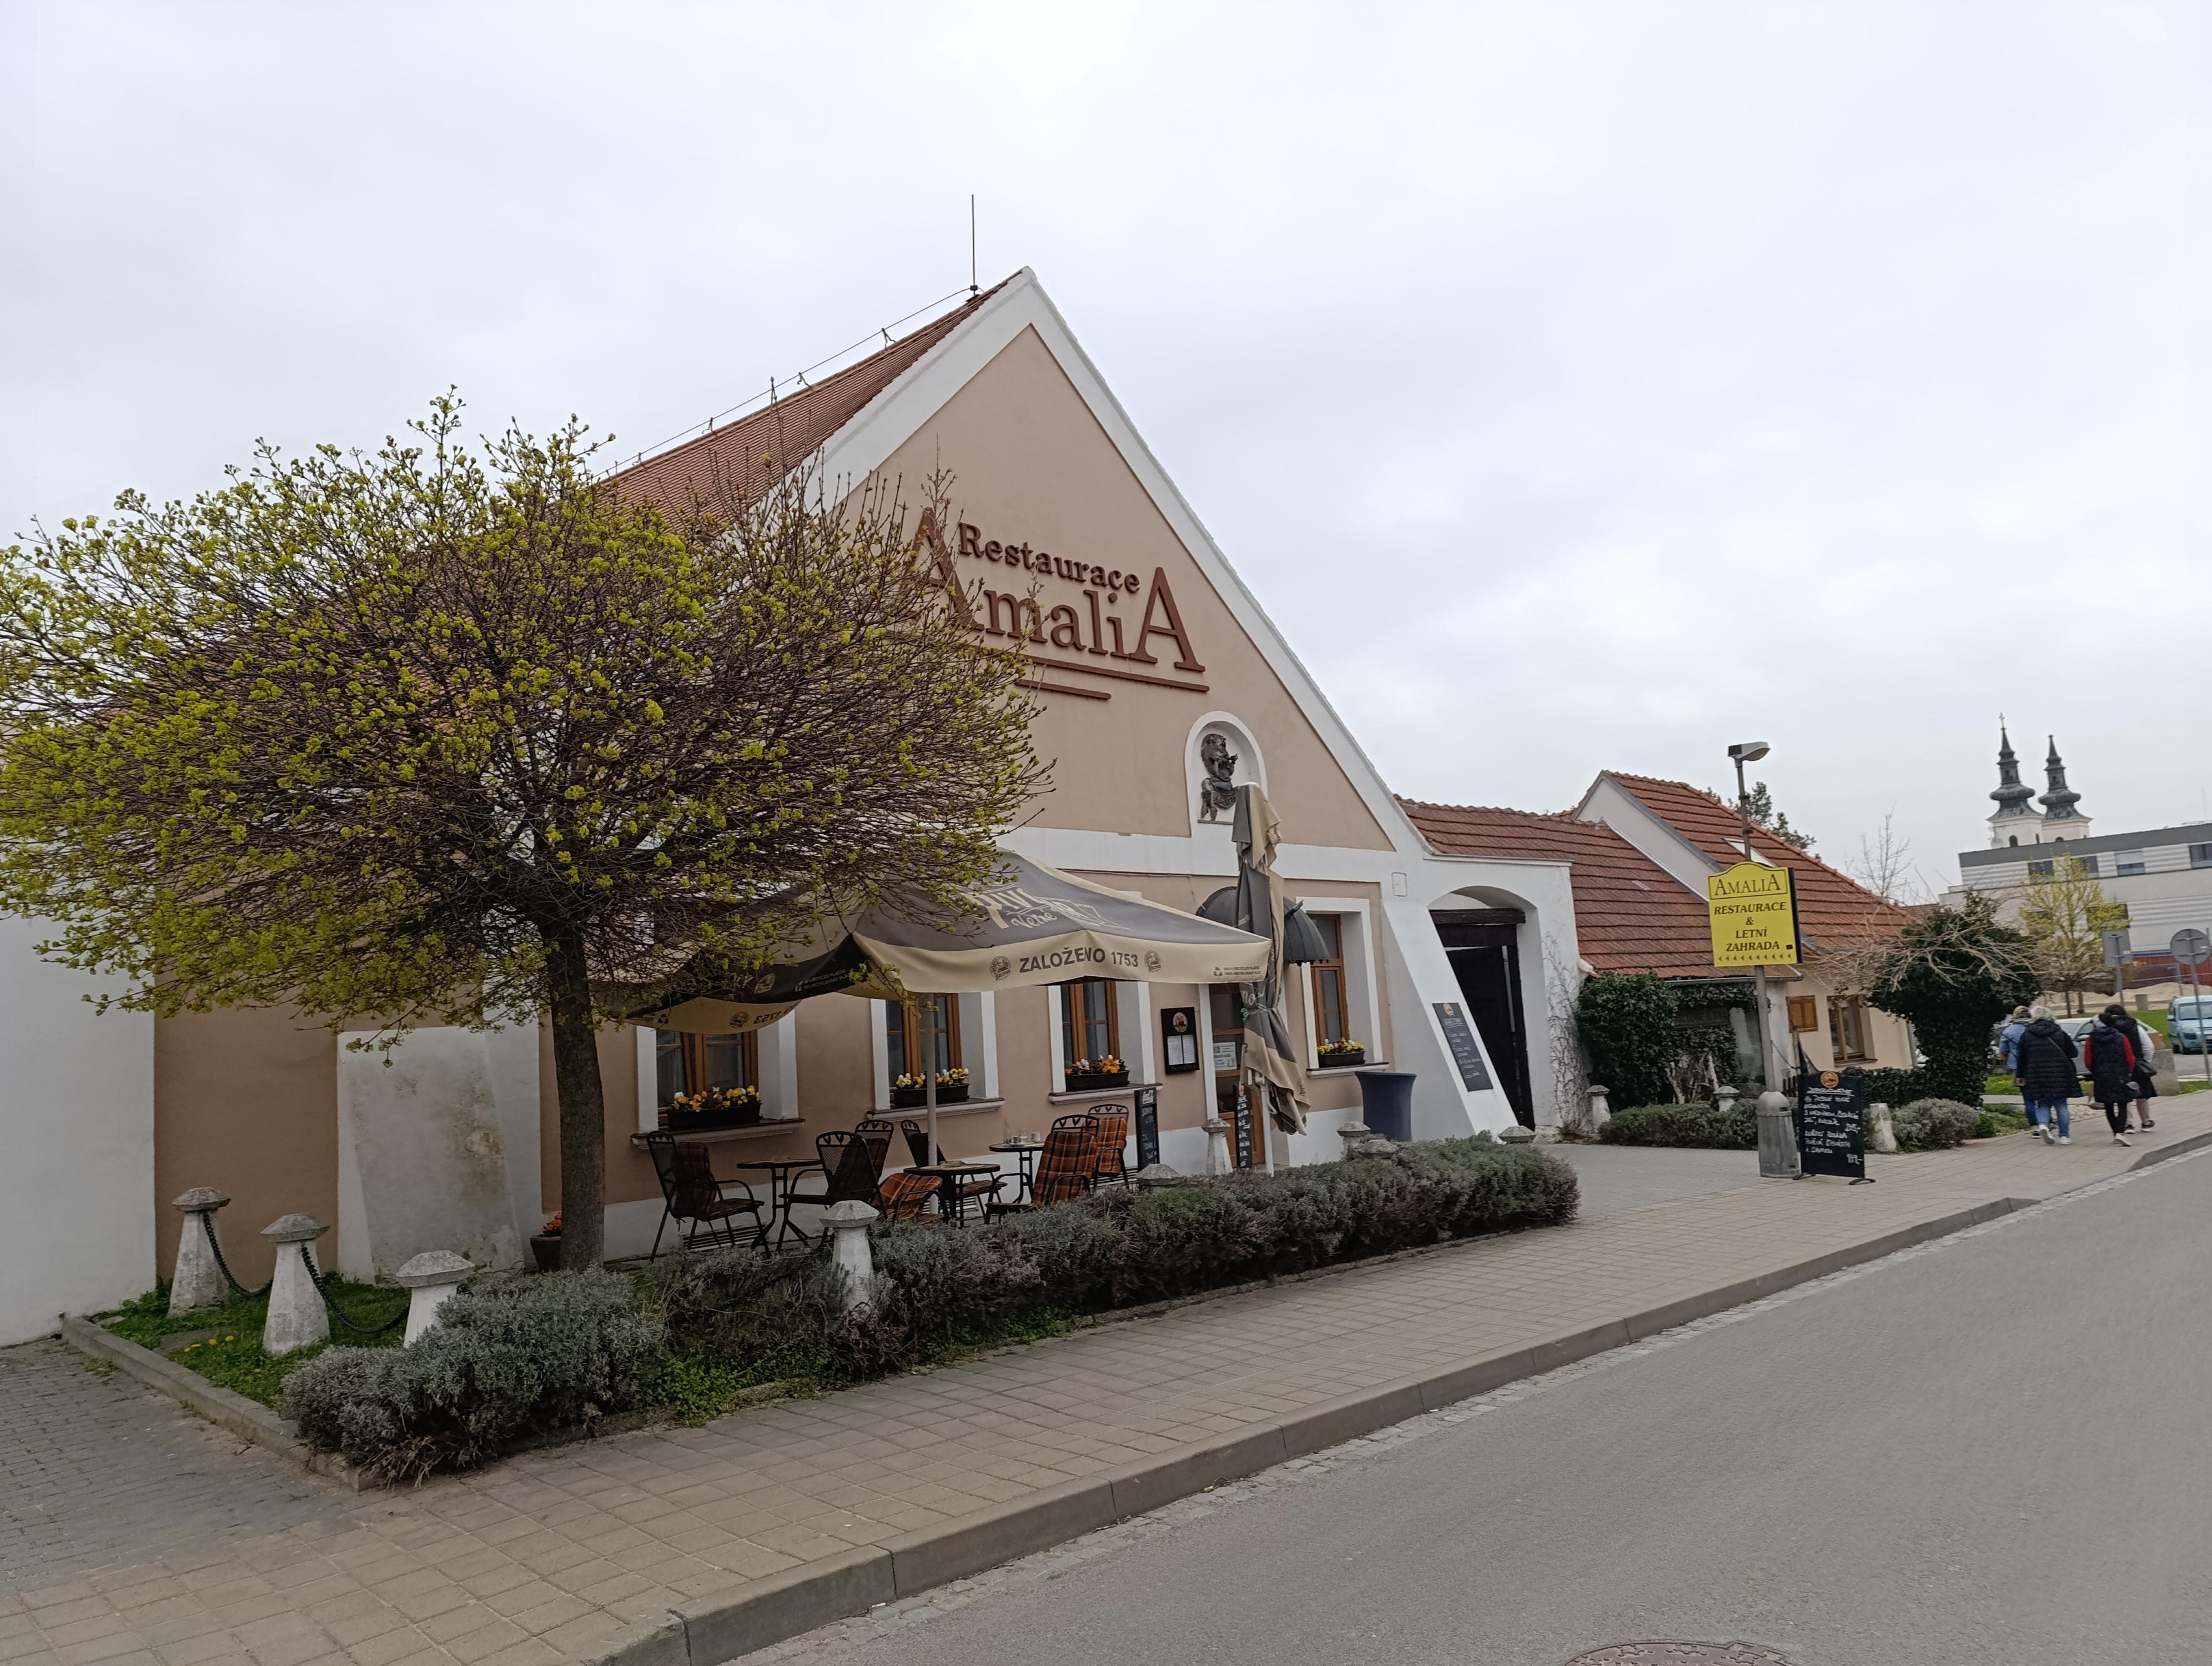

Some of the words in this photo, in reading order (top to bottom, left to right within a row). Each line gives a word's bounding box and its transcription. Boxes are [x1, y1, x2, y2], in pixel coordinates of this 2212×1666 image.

[958, 521, 1140, 594] Restaurace
[1714, 873, 1782, 896] AMALIA
[1714, 901, 1787, 915] RESTAURACE
[1745, 917, 1754, 926] &
[1735, 926, 1768, 939] LETNÍ
[1726, 941, 1780, 952] ZAHRADA
[1019, 946, 1106, 973] ZALOŽENO
[1110, 951, 1138, 967] 1753
